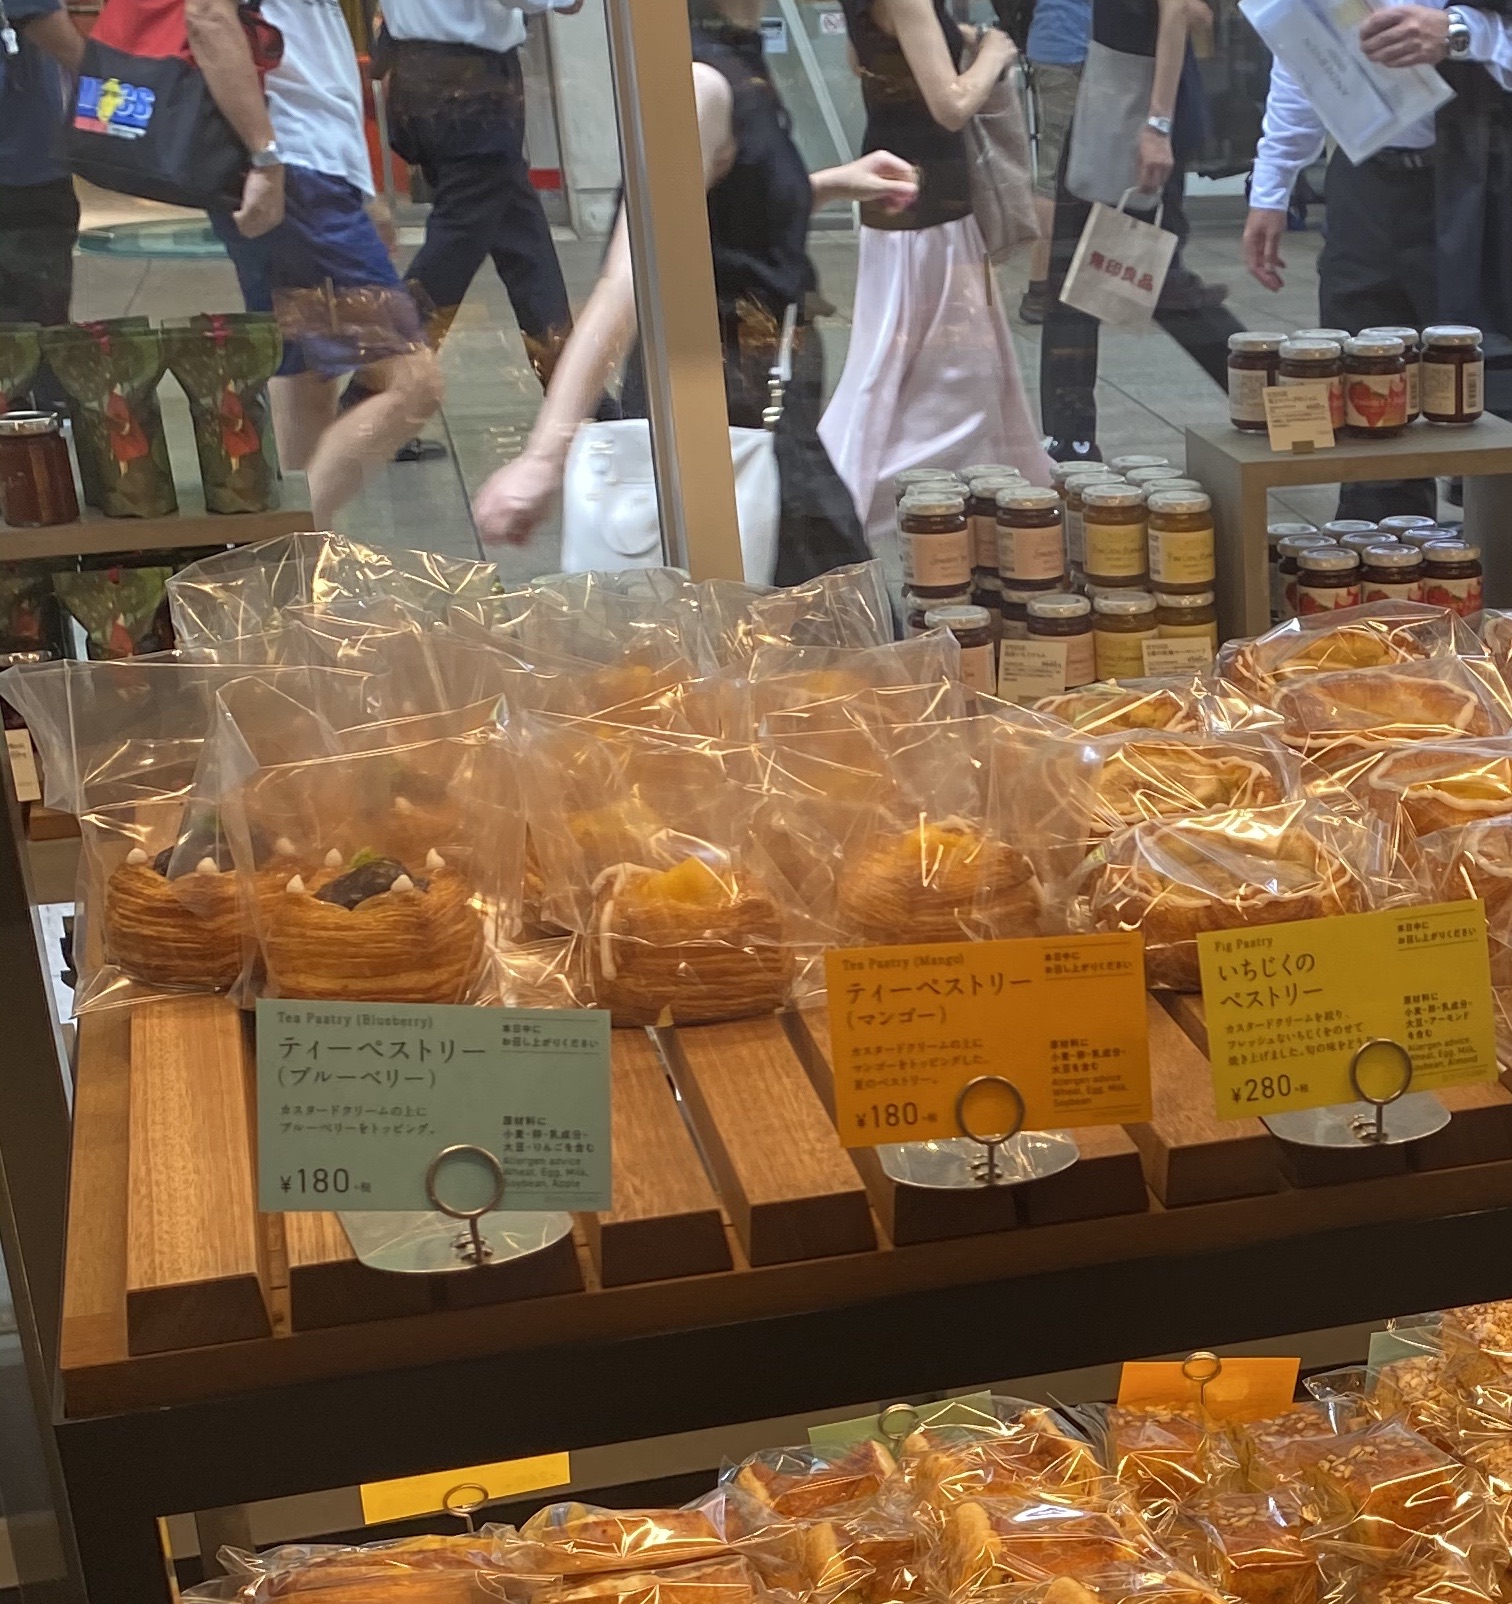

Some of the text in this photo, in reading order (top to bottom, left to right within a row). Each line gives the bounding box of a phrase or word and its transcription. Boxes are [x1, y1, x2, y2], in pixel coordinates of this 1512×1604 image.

[1214, 940, 1233, 954] Fig
[1217, 952, 1316, 982] いちじくの
[844, 971, 1033, 1005] ティーペストリー
[1218, 981, 1324, 1010] ペストリー
[276, 1011, 301, 1024] Tea
[305, 1012, 351, 1027] Pastry
[278, 1035, 486, 1064] ティーペストリー
[277, 1065, 436, 1089] （ブルーベリー）
[1230, 1073, 1292, 1103] ¥280
[855, 1101, 919, 1129] ¥180
[280, 1168, 350, 1193] ¥180
